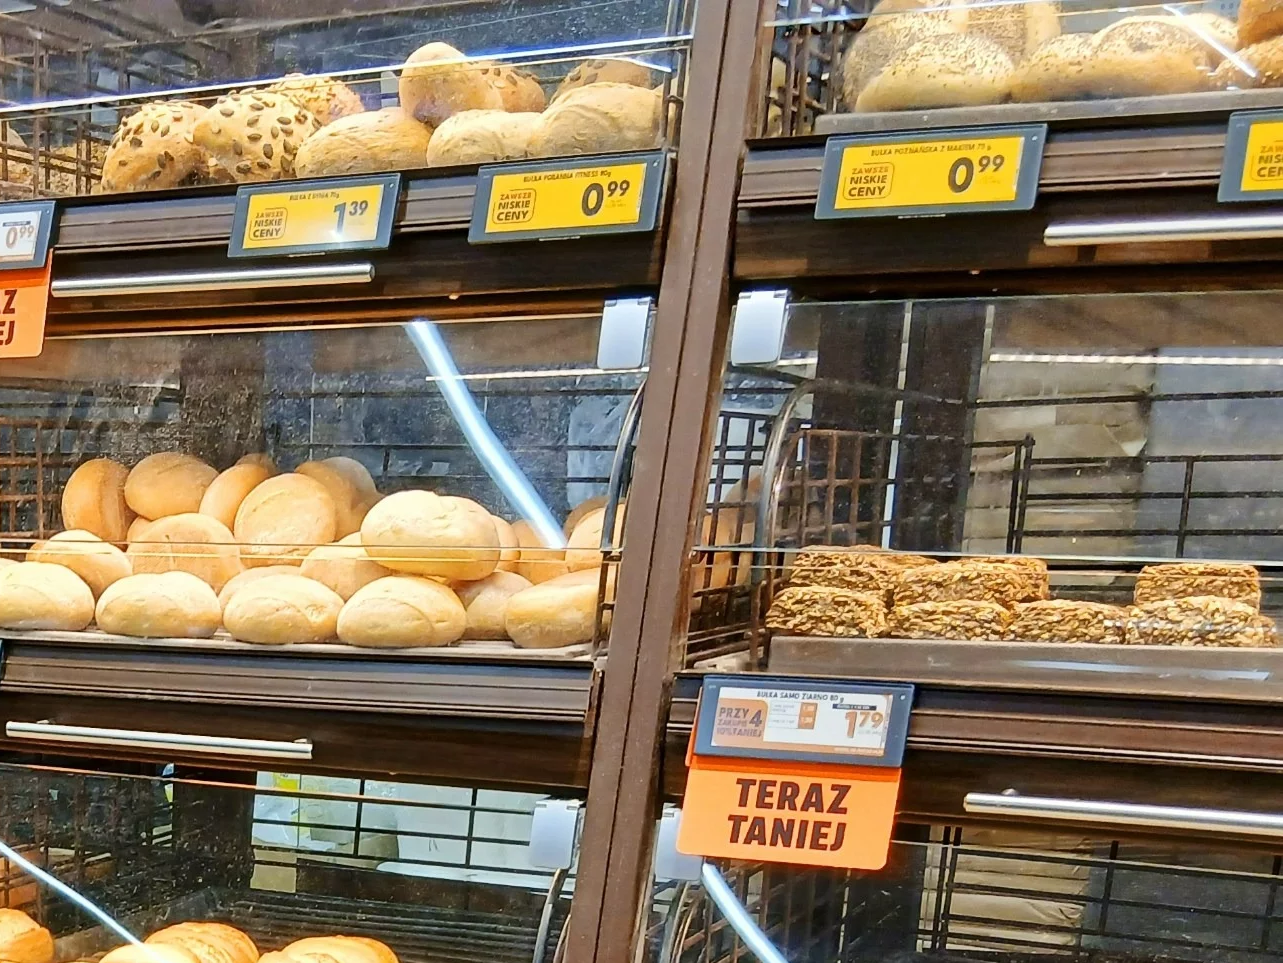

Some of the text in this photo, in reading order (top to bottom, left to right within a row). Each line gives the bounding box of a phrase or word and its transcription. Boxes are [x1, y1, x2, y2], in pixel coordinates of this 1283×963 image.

[851, 165, 889, 177] ZAWSZE
[849, 174, 888, 186] NISKIE
[848, 186, 886, 198] CENY
[497, 199, 531, 210] NISKIE
[496, 210, 529, 222] CENY
[253, 218, 283, 228] NISKIE
[252, 228, 281, 239] CENY
[801, 693, 828, 701] ZIARNO
[718, 706, 763, 728] PRZY 4
[735, 777, 852, 815] TERAZ
[726, 814, 847, 852] TANIEJ
